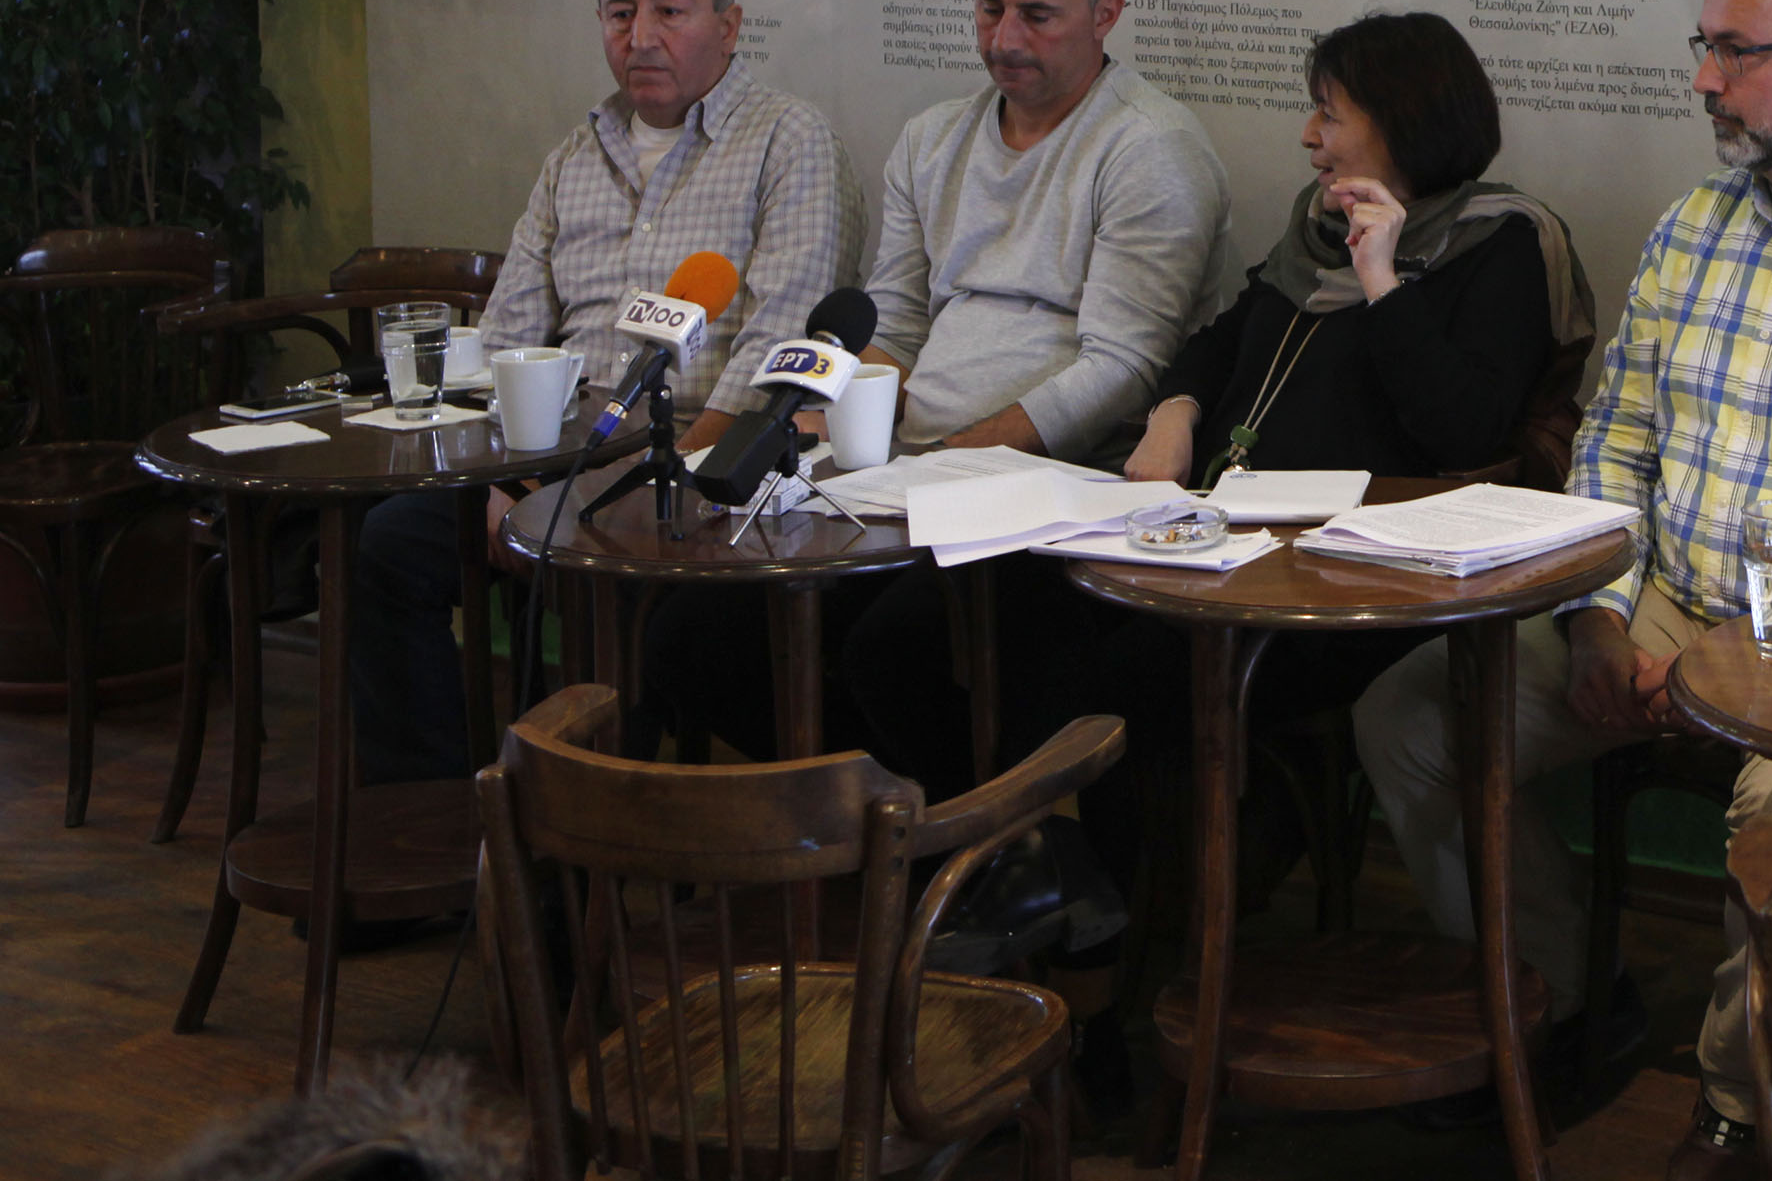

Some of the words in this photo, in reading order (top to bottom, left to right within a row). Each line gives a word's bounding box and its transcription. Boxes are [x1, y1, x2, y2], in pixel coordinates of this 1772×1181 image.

[1160, 0, 1227, 18] Παγκόσμιος
[1229, 2, 1279, 21] Πόλεμος
[1280, 9, 1302, 18] που
[1535, 1, 1570, 18] Ζώνη
[1572, 6, 1593, 16] και
[1595, 4, 1635, 21] Λιμήν
[1468, 17, 1561, 37] Θεσσαλονίκης"
[1563, 21, 1618, 39] (ΕΖΛΘ).
[625, 298, 685, 327] TV100
